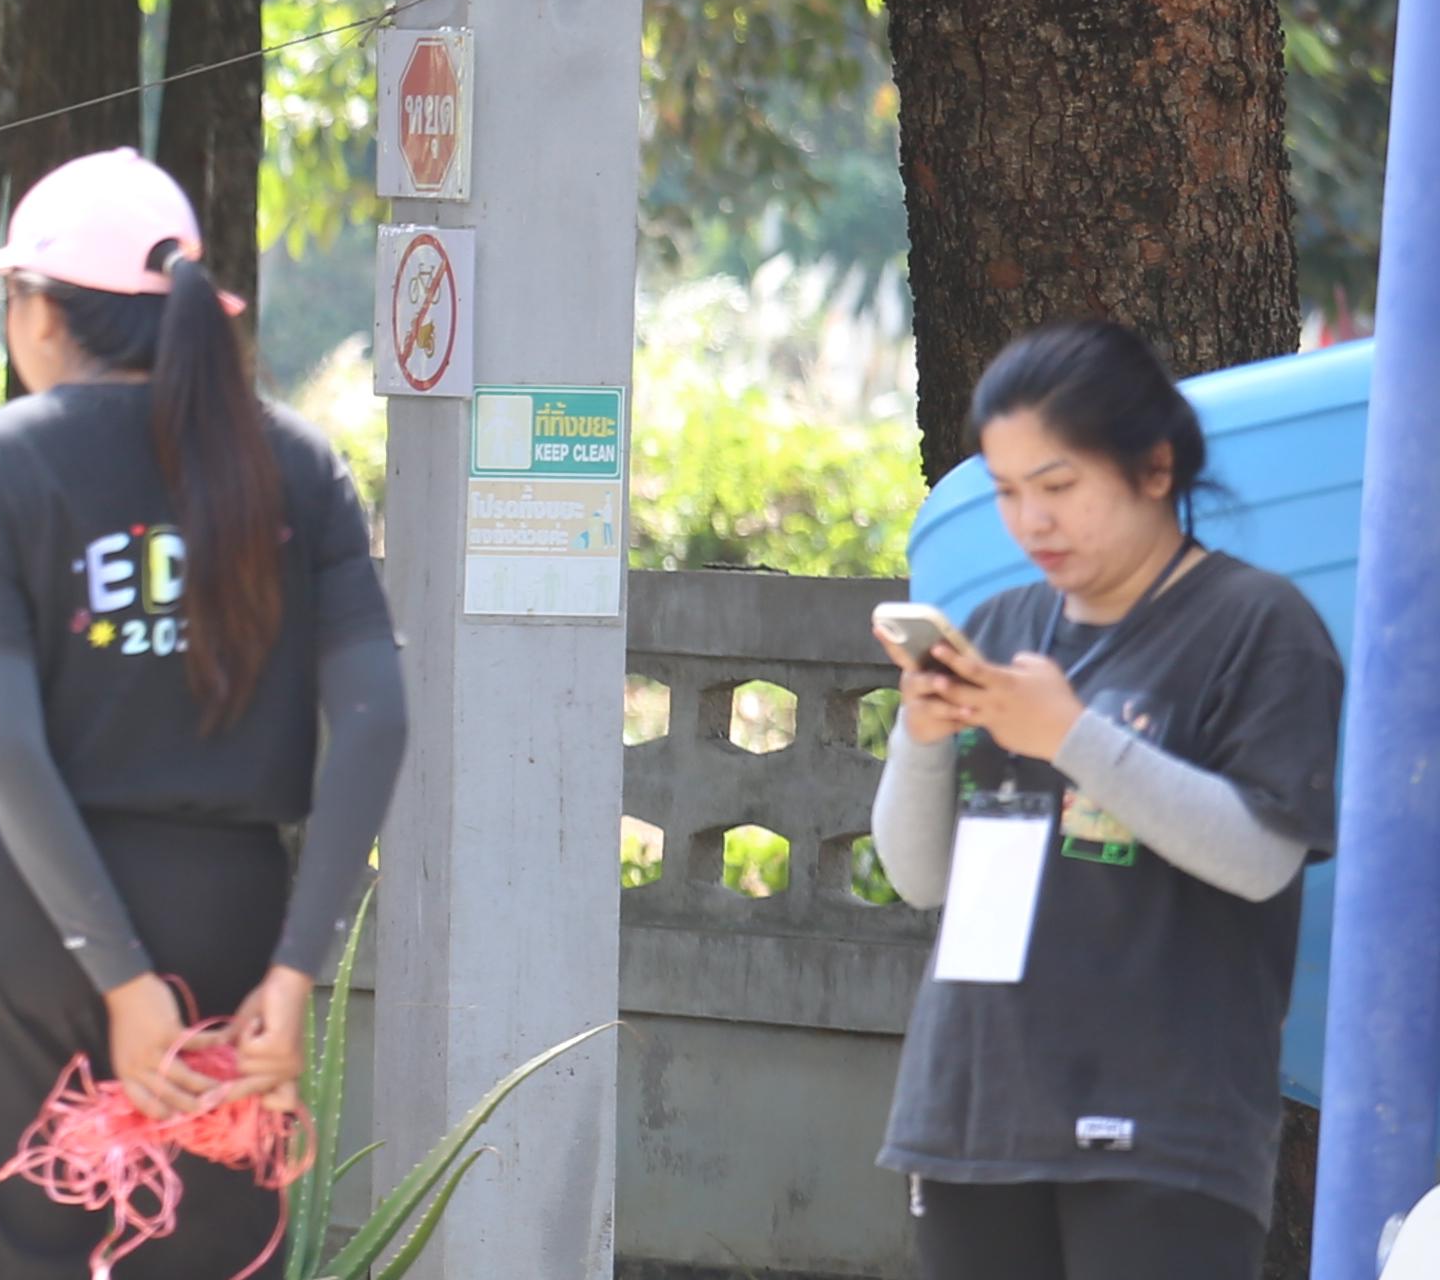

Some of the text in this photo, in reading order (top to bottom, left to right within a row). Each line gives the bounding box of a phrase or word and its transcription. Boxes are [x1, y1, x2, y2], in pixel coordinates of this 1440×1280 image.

[404, 94, 454, 159] หยุด
[535, 402, 616, 437] ที่ทิ้งขยะ
[535, 443, 615, 462] KEEP CLEAN
[85, 526, 187, 614] ED
[121, 617, 188, 656] 20
